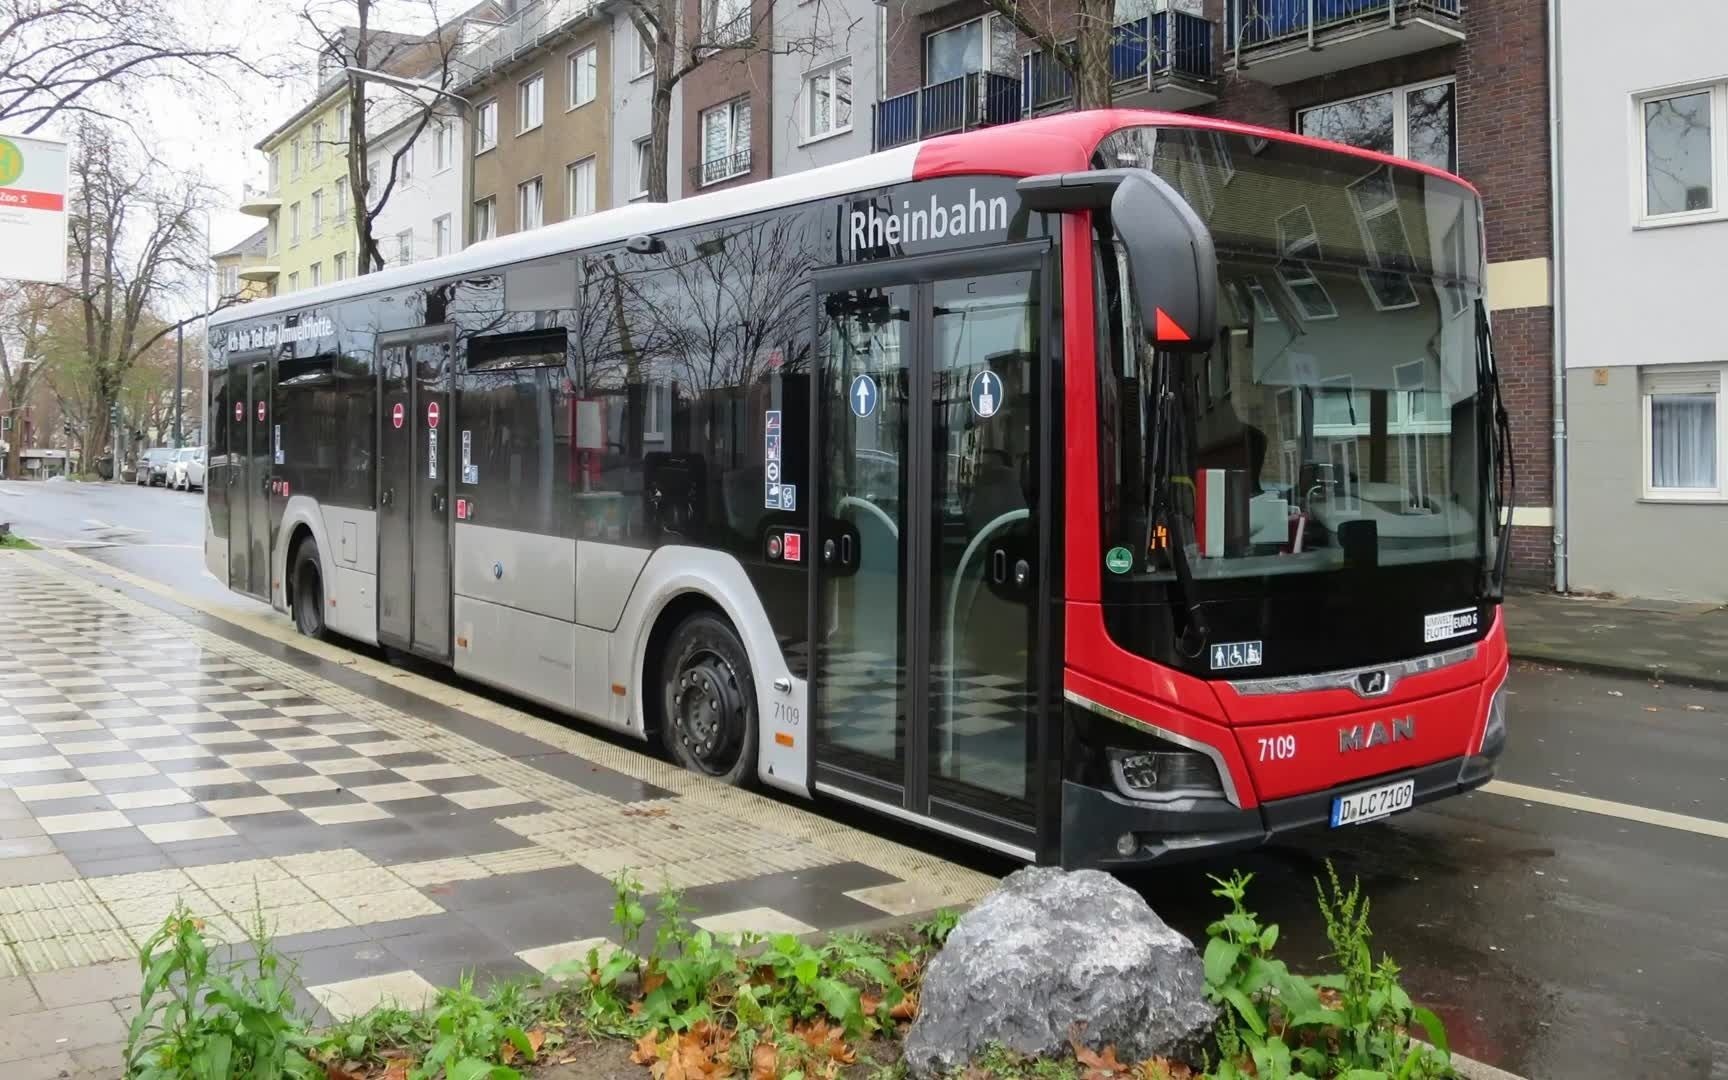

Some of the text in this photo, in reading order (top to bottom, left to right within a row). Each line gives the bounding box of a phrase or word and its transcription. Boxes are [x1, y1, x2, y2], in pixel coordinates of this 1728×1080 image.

[850, 188, 1007, 250] Rheinbahn
[1426, 615, 1453, 627] UMWELT
[1426, 625, 1453, 640] FLOTTE
[1453, 613, 1478, 629] EURO 6
[773, 701, 800, 726] 7109
[1339, 715, 1415, 753] MAN
[1257, 735, 1296, 762] 7109
